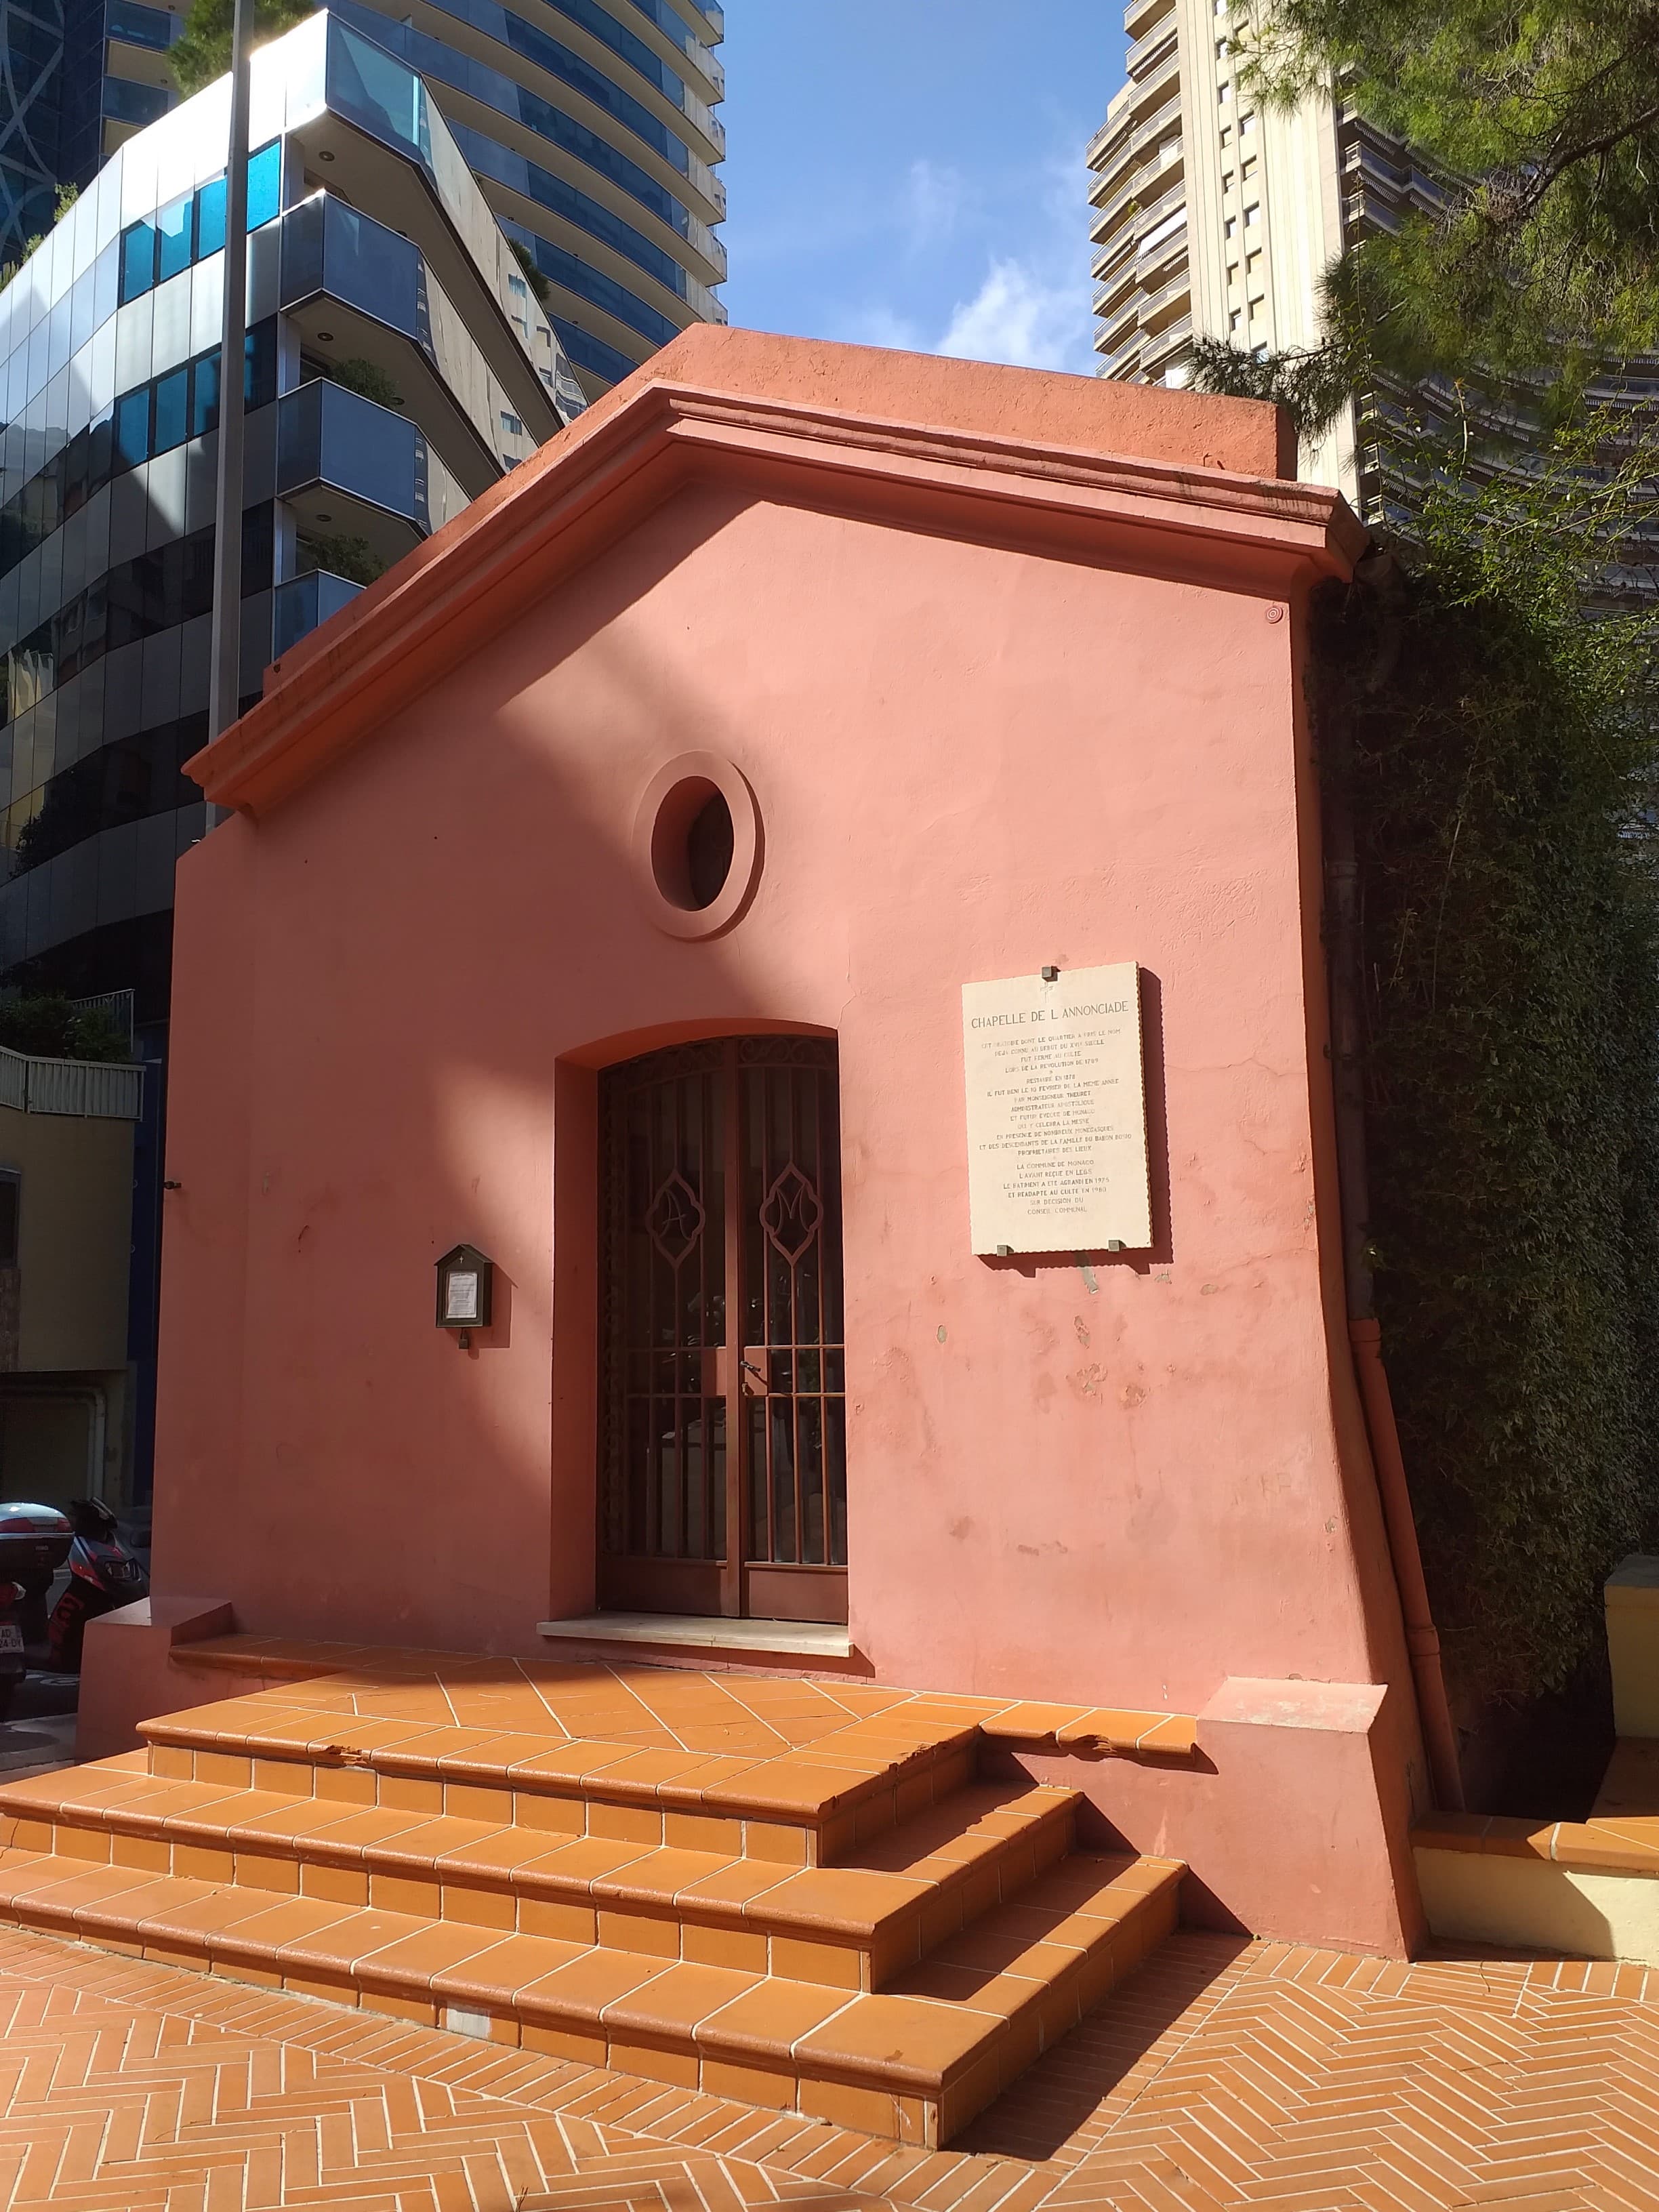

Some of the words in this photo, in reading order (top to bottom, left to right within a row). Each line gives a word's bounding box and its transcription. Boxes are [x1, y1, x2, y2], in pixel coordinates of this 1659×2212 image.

[971, 1012, 1025, 1029] CHAPELLE
[1031, 1010, 1045, 1022] DE
[1062, 1001, 1128, 1019] ANNONCIADE
[1048, 1033, 1075, 1042] QUARTIER
